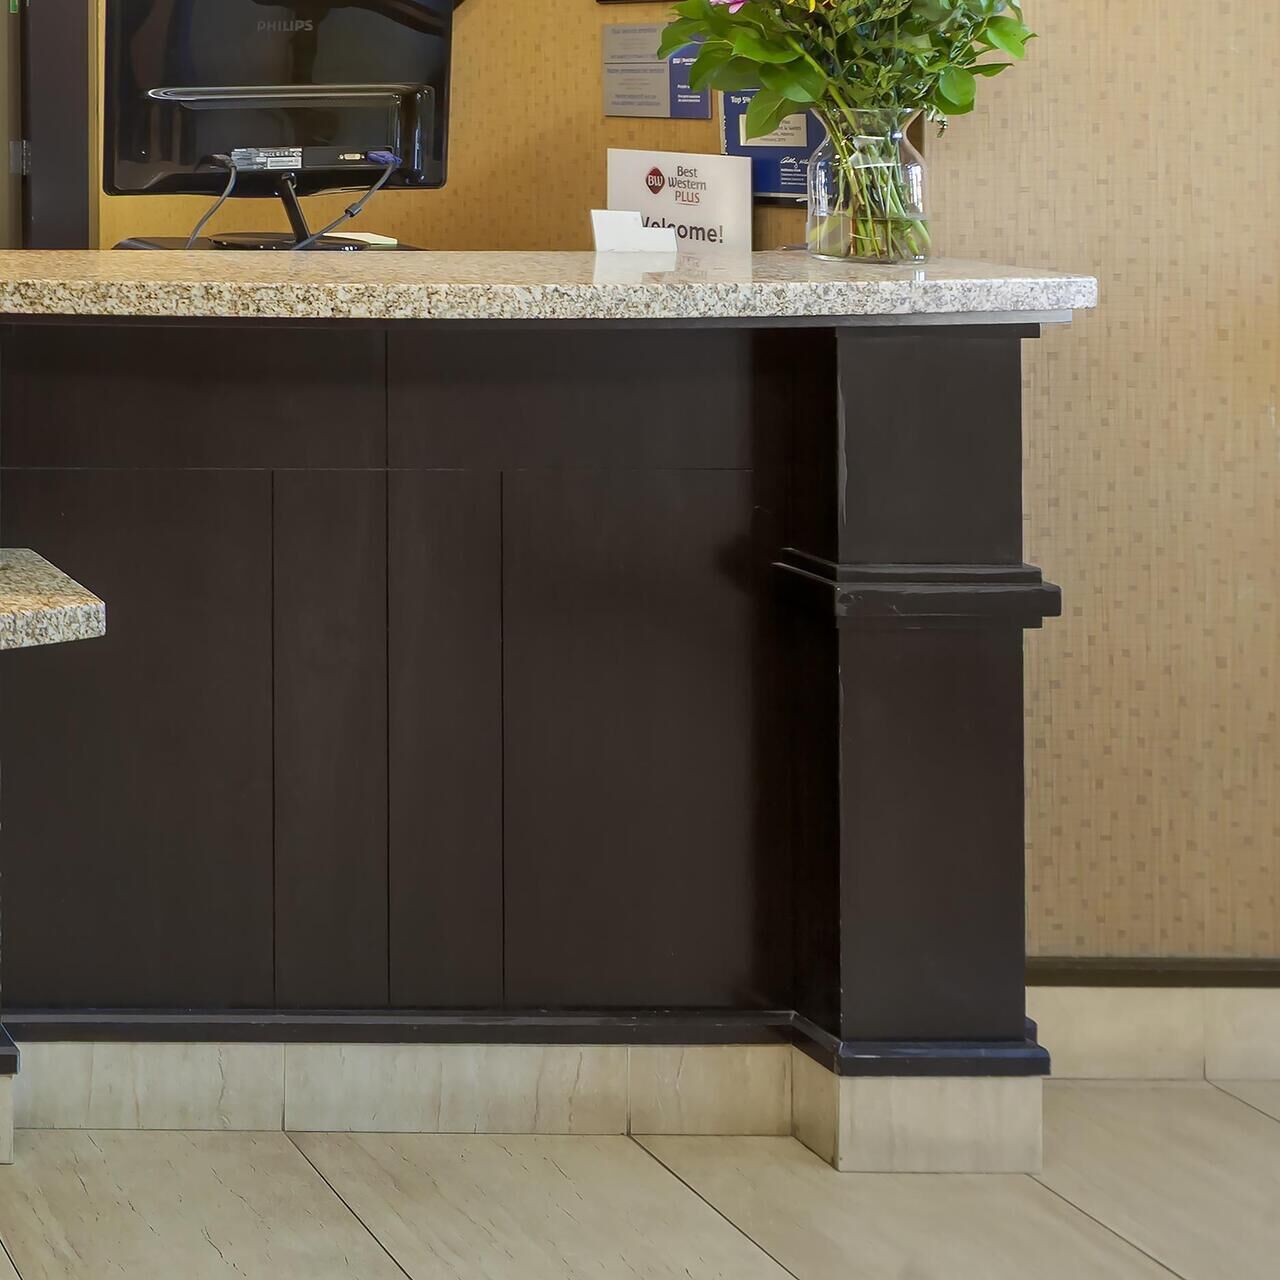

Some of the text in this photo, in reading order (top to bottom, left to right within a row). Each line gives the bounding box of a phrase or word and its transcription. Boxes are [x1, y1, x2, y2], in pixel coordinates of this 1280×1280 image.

[257, 20, 314, 32] PHILIPS
[677, 166, 698, 178] Best
[648, 175, 707, 191] BW Western
[675, 190, 700, 204] PLUS
